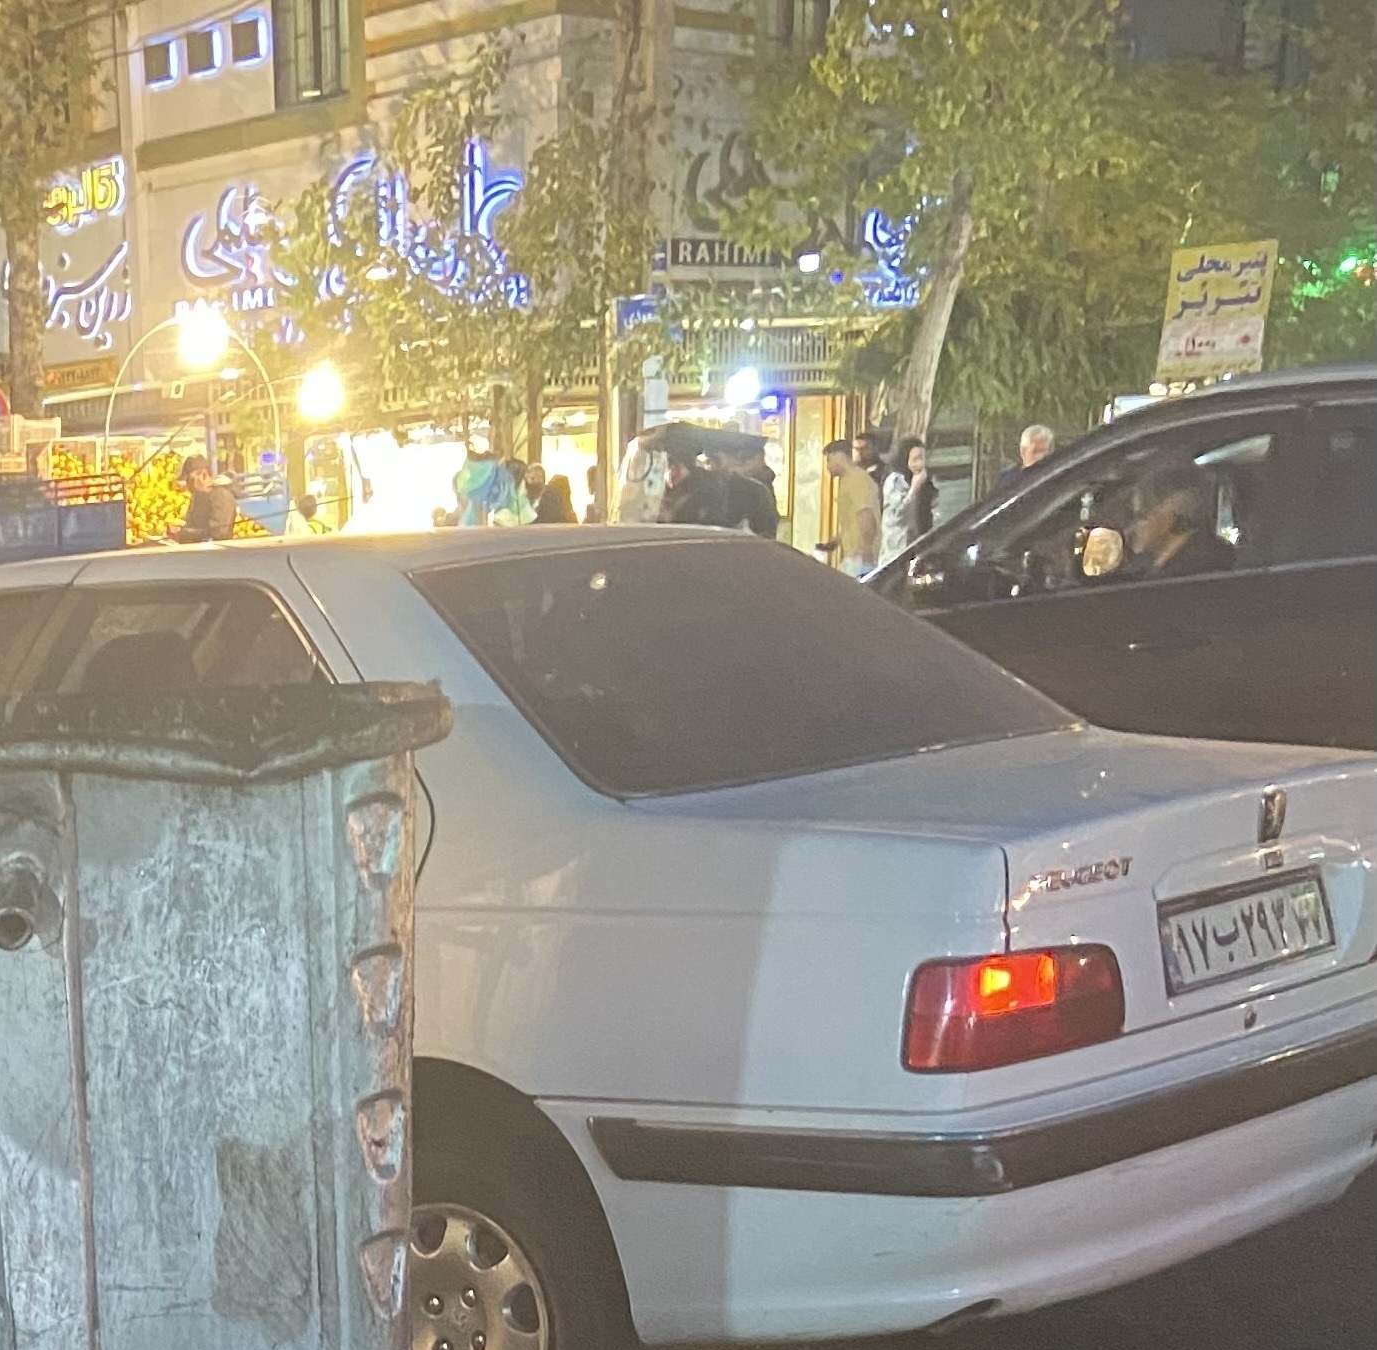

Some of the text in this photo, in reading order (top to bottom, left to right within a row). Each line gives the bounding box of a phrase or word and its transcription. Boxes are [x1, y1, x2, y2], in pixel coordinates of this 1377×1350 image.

[678, 239, 772, 265] RAHIMI
[1176, 251, 1269, 283] پنیر محلی
[1171, 279, 1263, 321] تبریز
